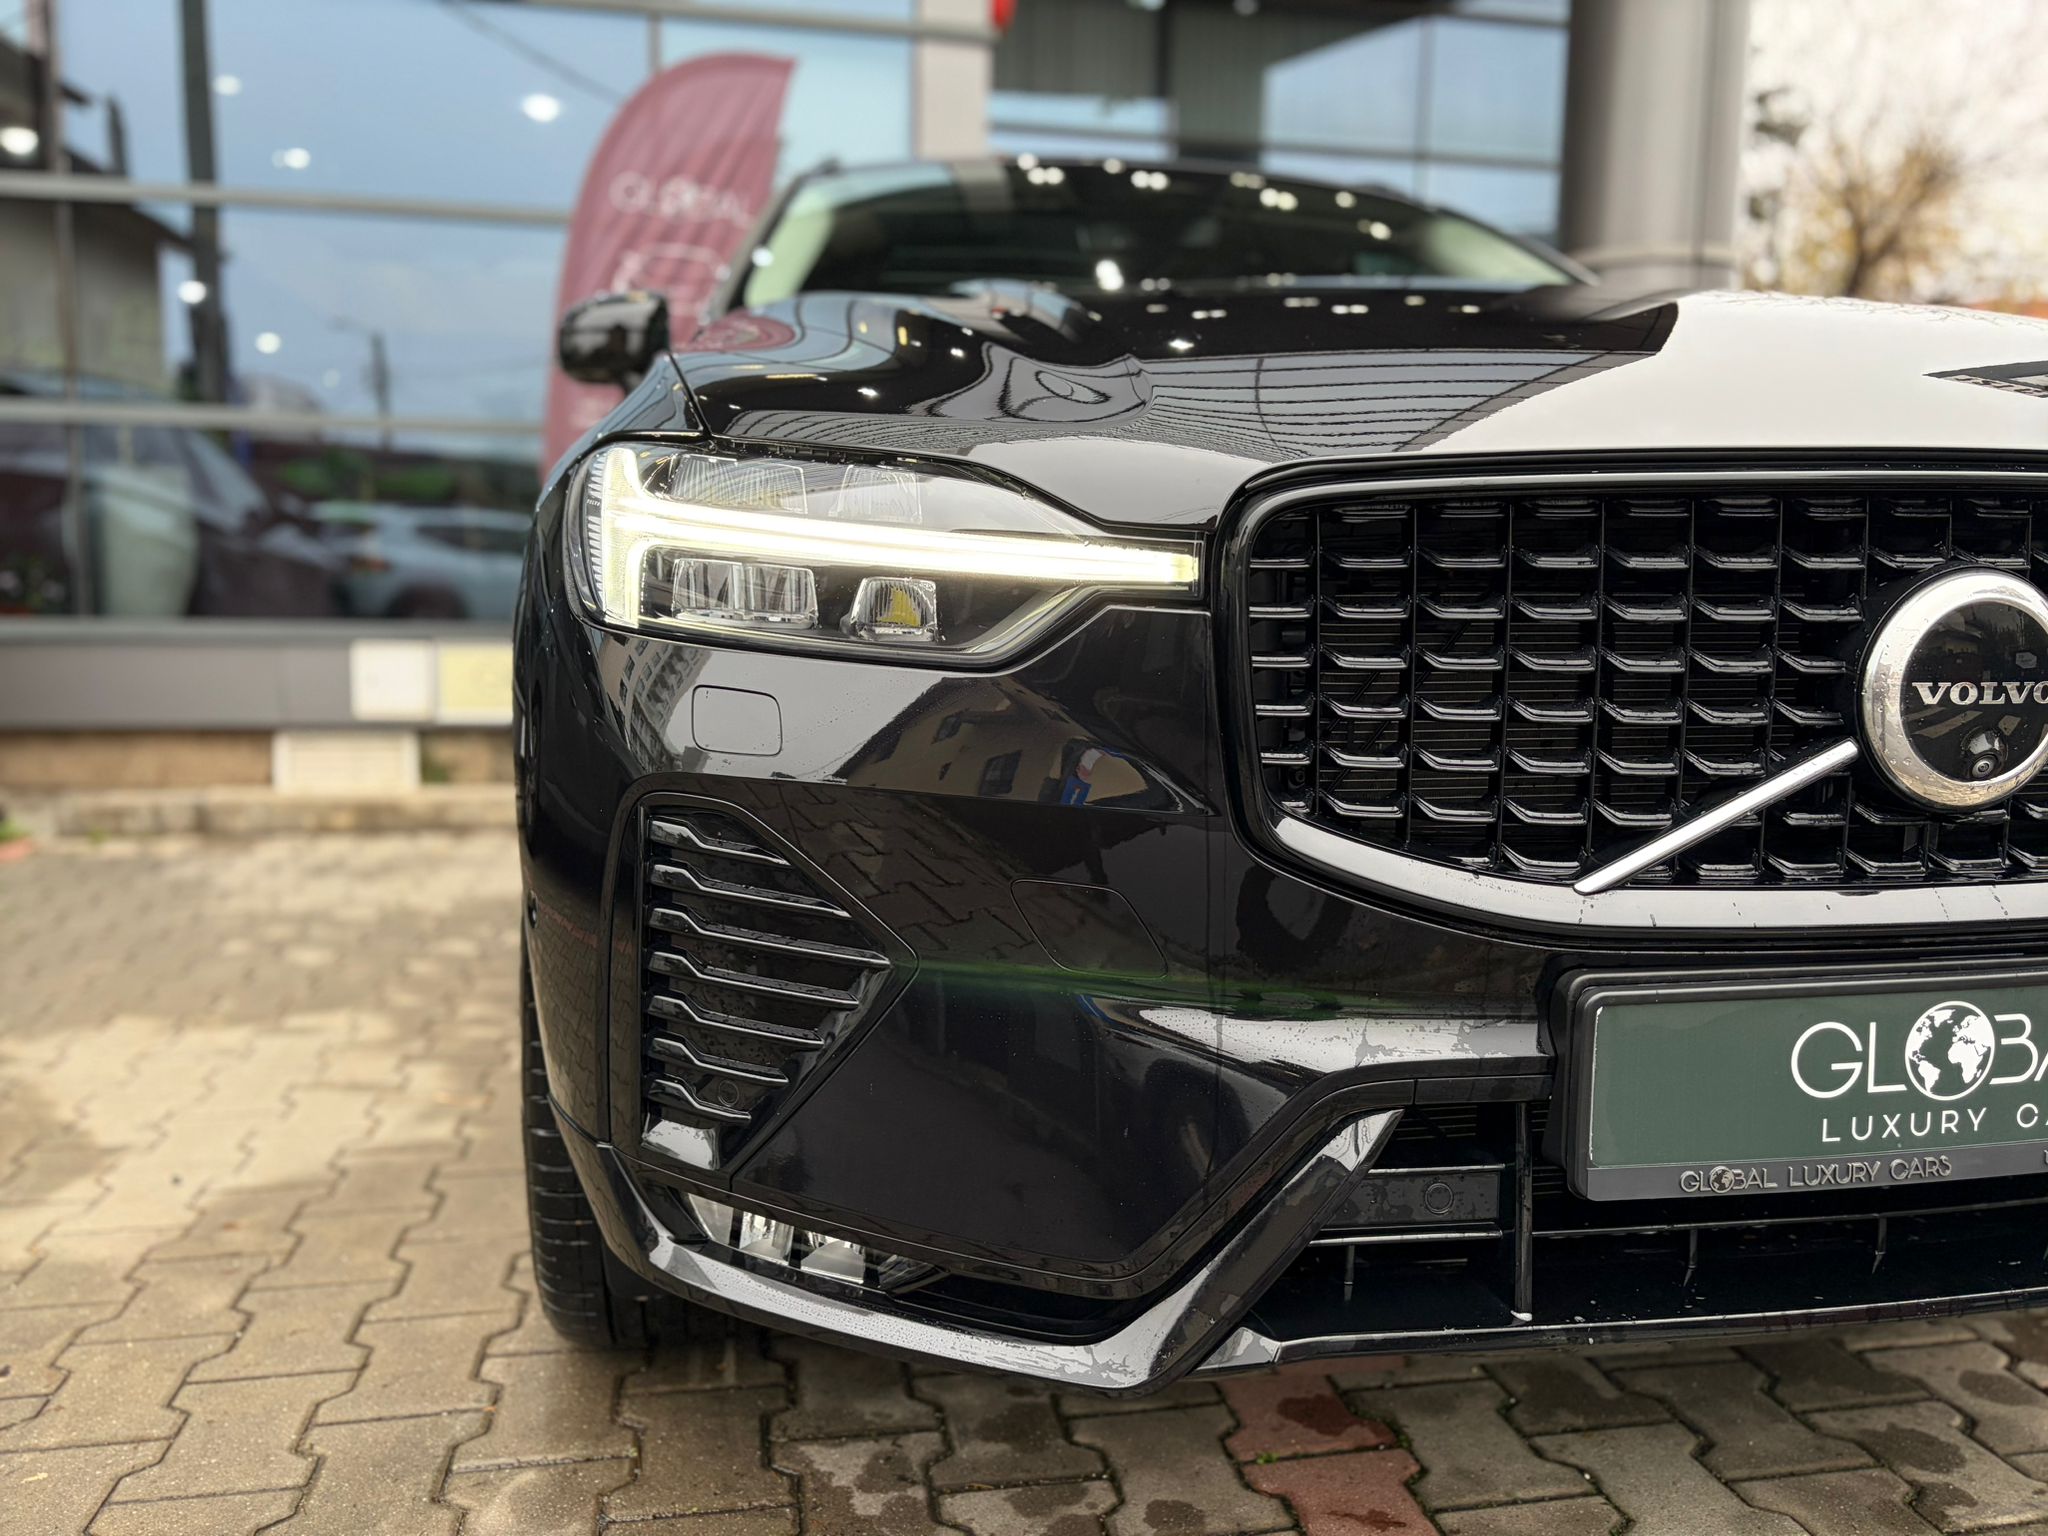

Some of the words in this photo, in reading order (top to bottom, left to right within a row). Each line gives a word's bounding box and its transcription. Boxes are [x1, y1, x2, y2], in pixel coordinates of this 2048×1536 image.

[1791, 1001, 2048, 1100] GLOB
[1822, 1107, 1987, 1142] LUXURY
[2016, 1102, 2048, 1128] C
[1680, 1165, 1778, 1194] GLOBAL
[1788, 1160, 1881, 1188] LUXURY
[1889, 1154, 1952, 1181] CARS
